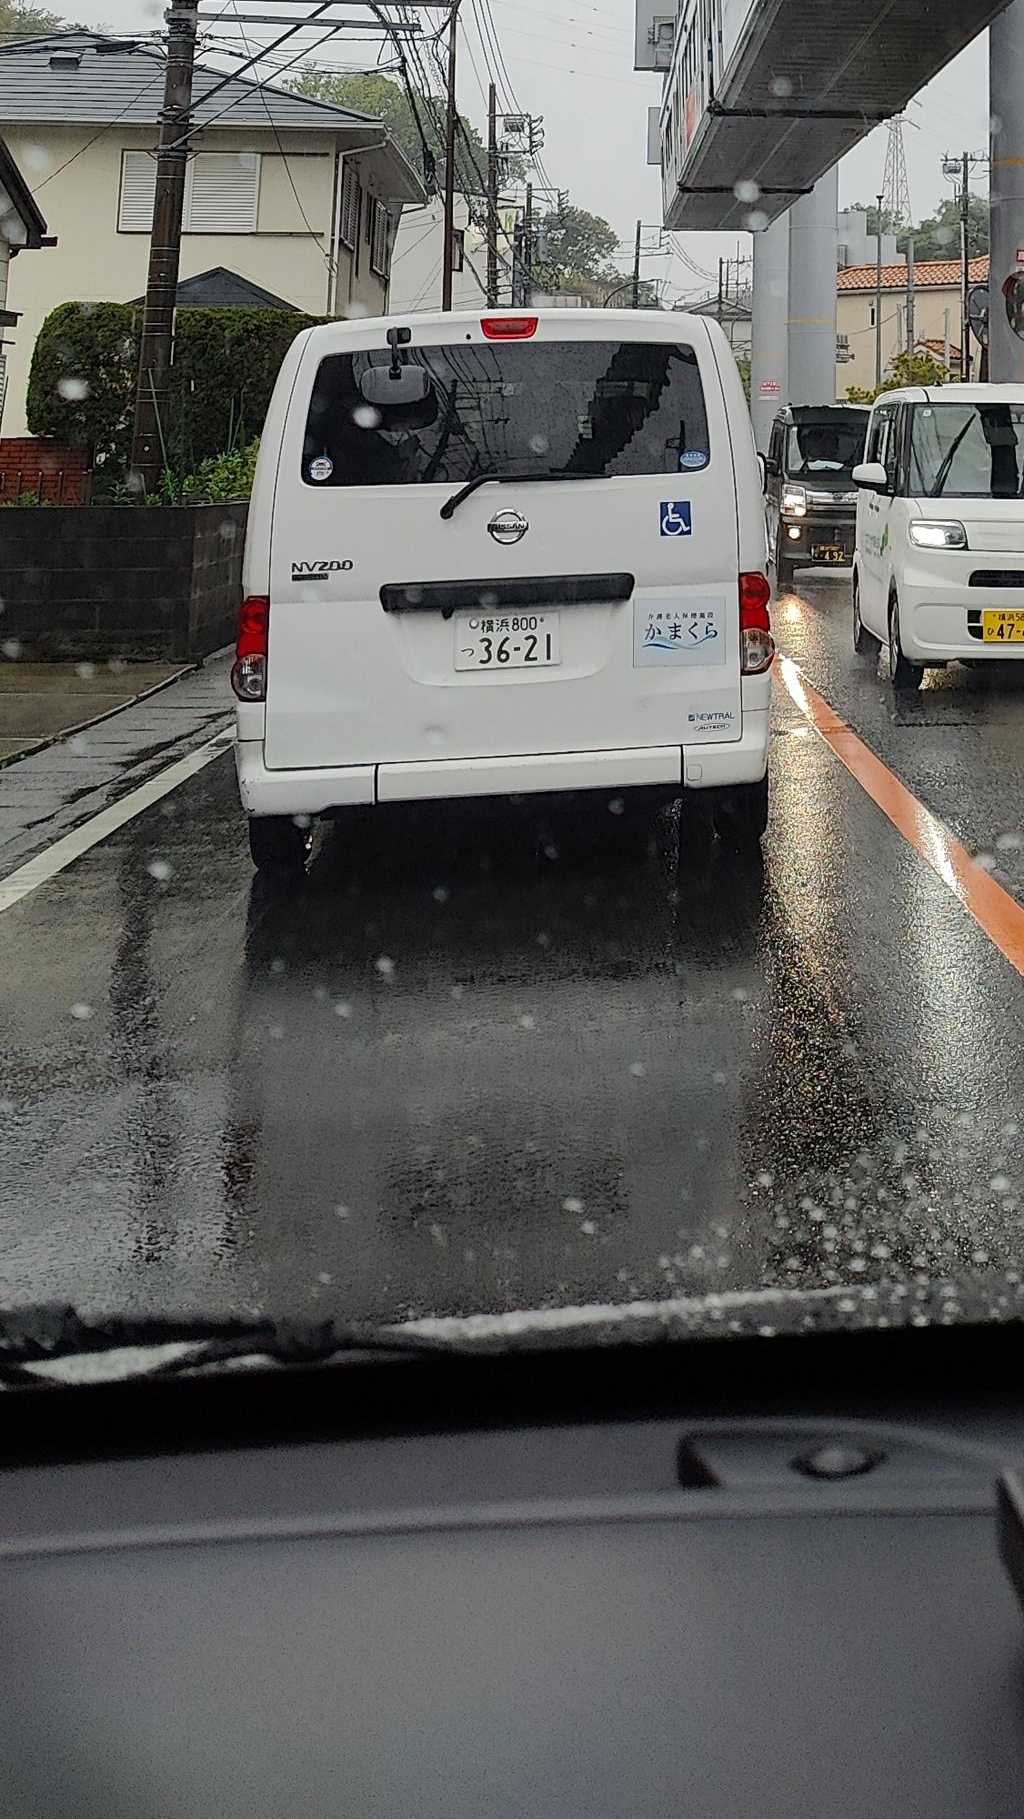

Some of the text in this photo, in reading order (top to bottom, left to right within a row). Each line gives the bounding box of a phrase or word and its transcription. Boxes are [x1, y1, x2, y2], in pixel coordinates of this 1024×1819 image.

[291, 560, 354, 573] NV200
[644, 622, 718, 640] かまくら
[479, 633, 551, 664] 36-21
[696, 711, 735, 721] NEWTRAL
